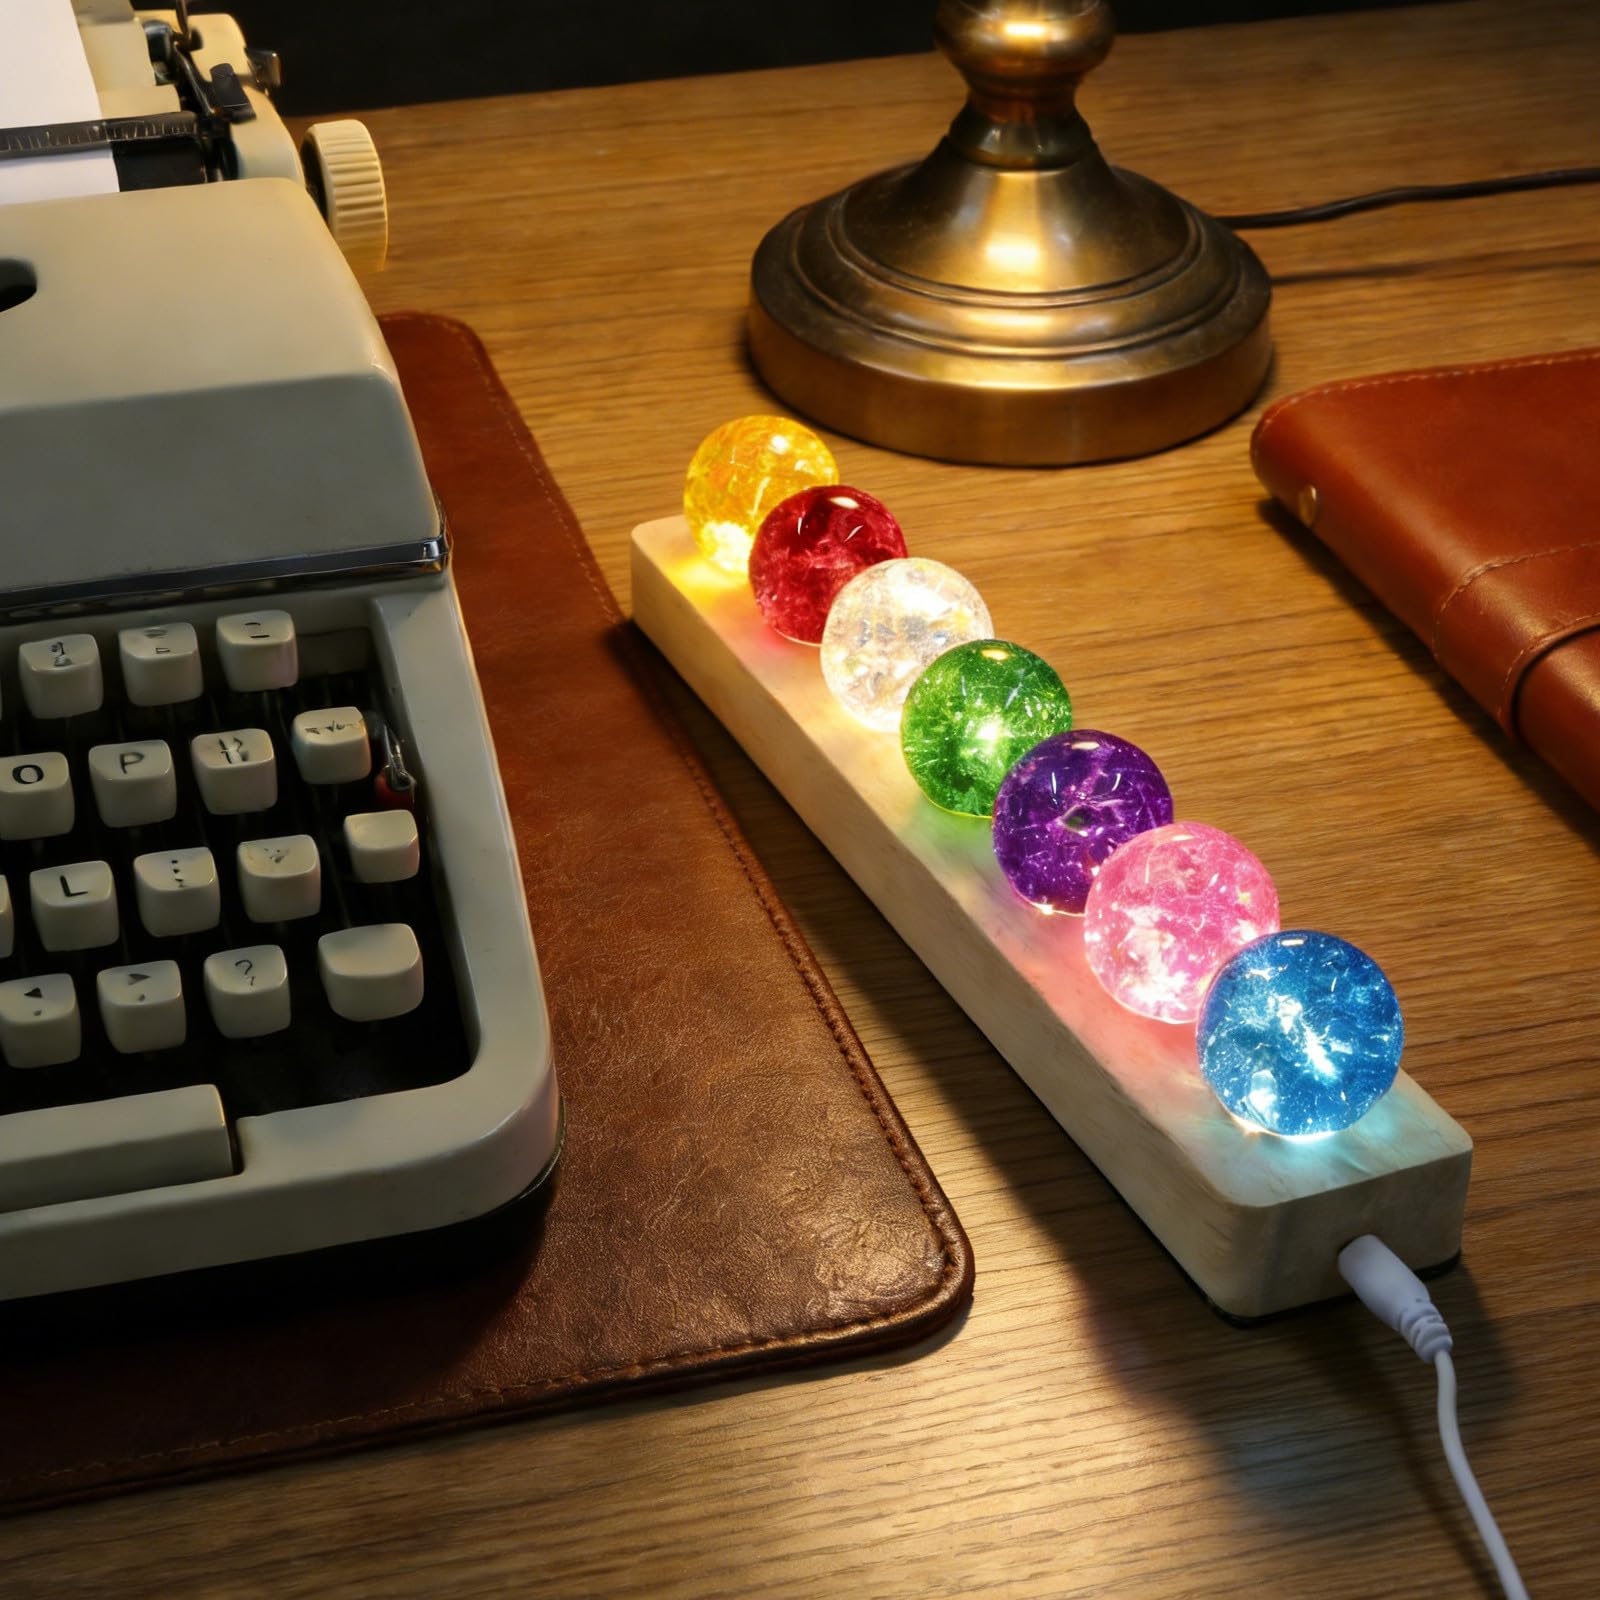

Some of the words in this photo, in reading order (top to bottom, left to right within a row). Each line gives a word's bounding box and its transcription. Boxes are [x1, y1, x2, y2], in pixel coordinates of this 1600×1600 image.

[119, 751, 146, 774] P
[12, 764, 44, 785] O
[59, 874, 89, 898] L
